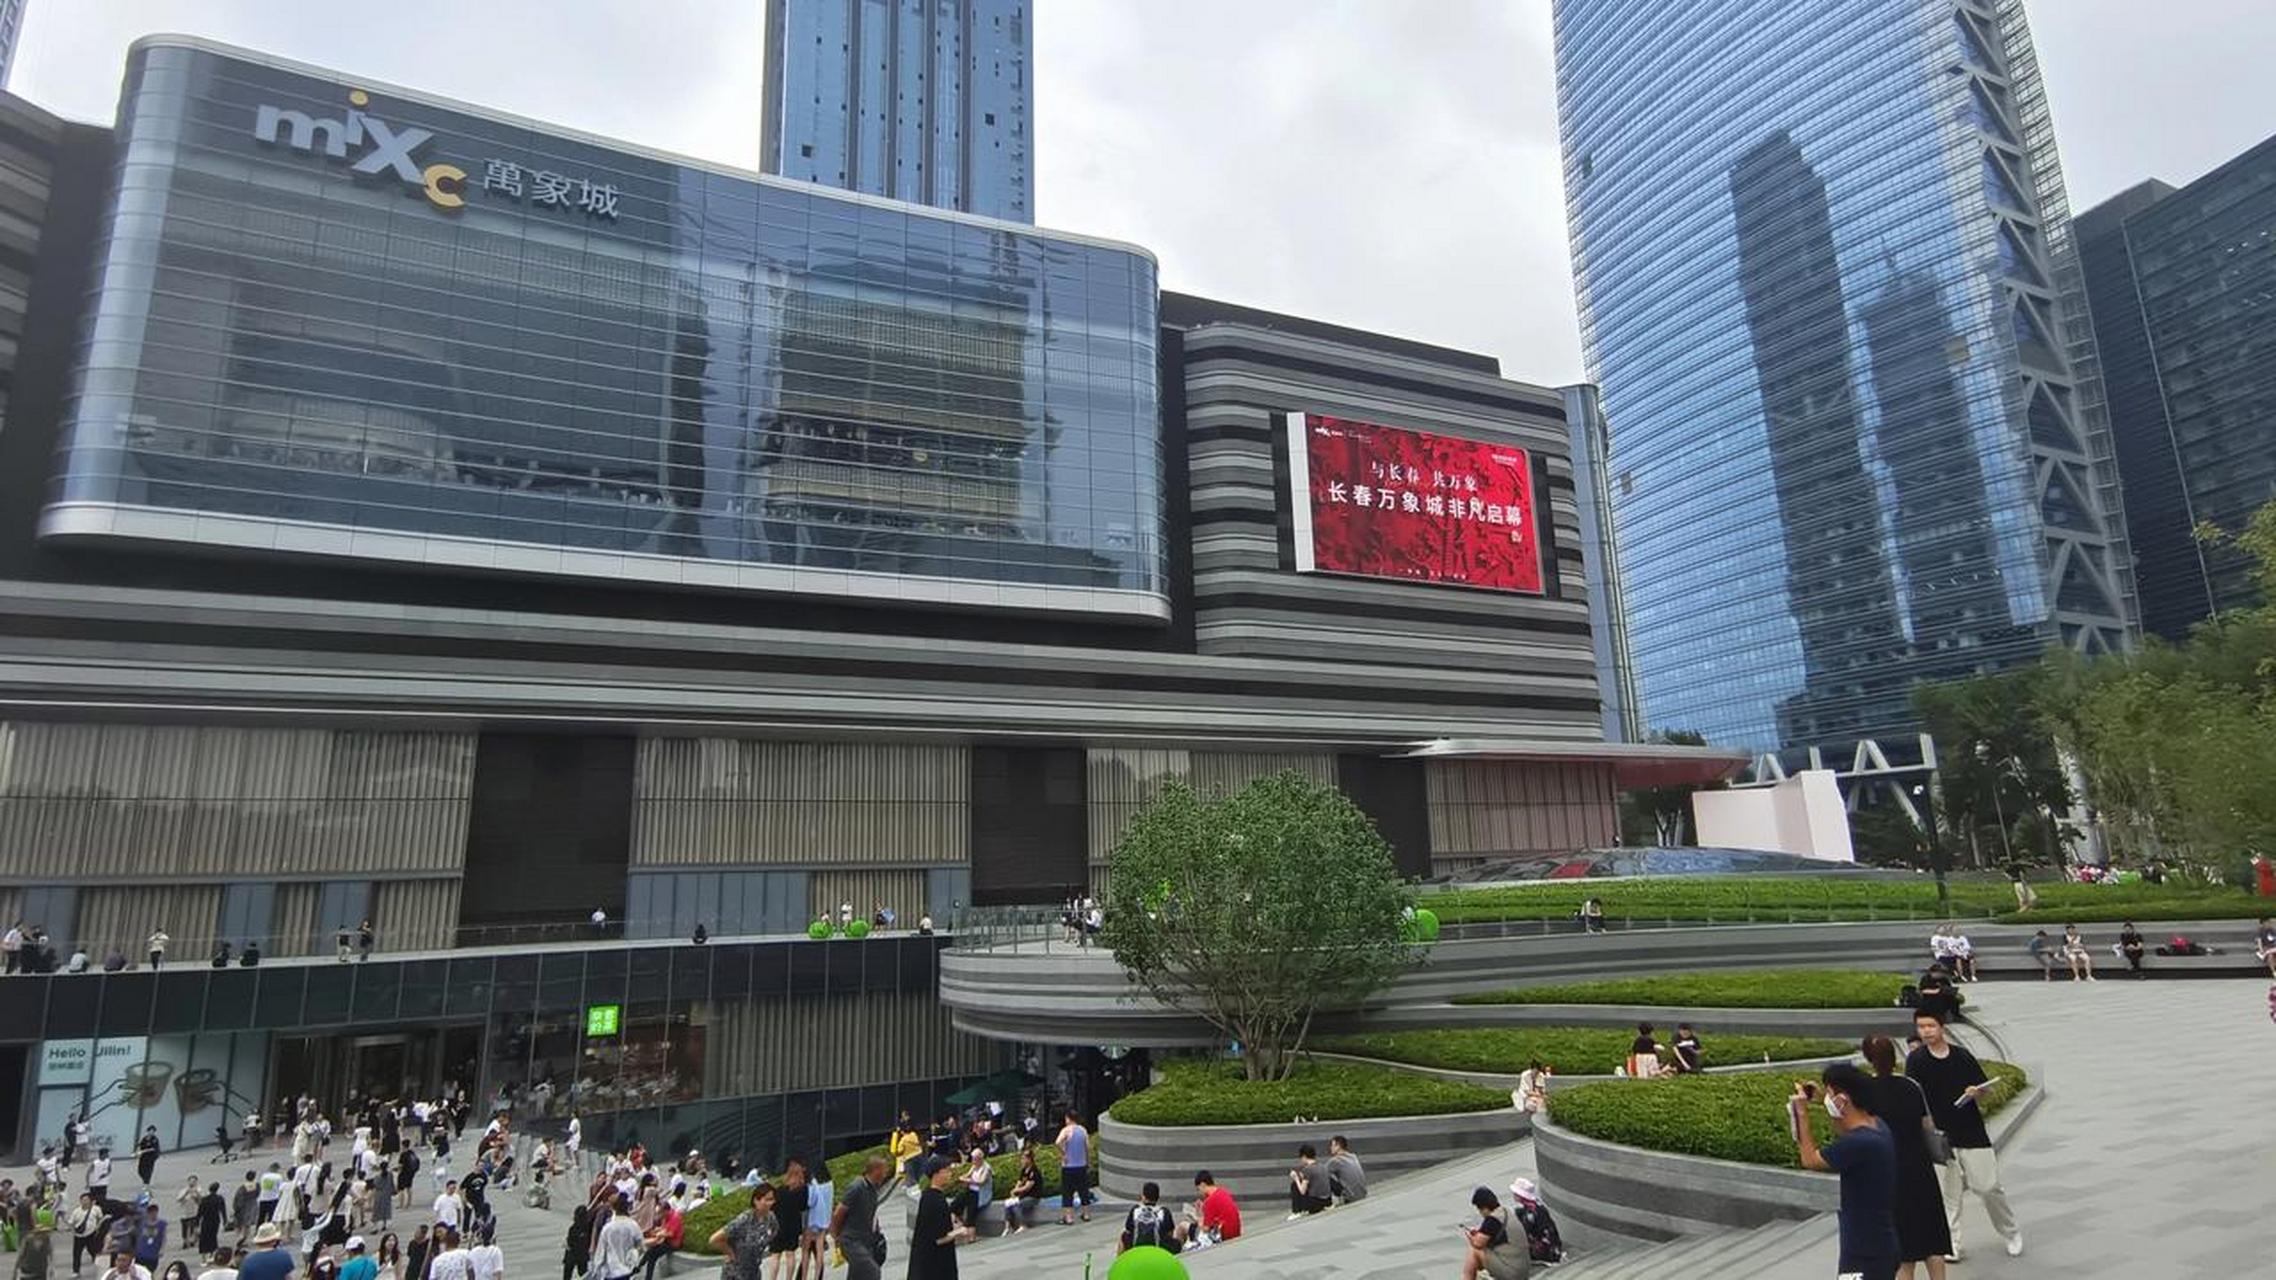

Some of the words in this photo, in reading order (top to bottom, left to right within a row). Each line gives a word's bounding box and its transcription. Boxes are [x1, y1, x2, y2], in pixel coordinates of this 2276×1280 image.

[484, 158, 619, 217] 萬象城
[1328, 480, 1522, 526] 长春万象城非凡启幕
[49, 1047, 86, 1059] Hello
